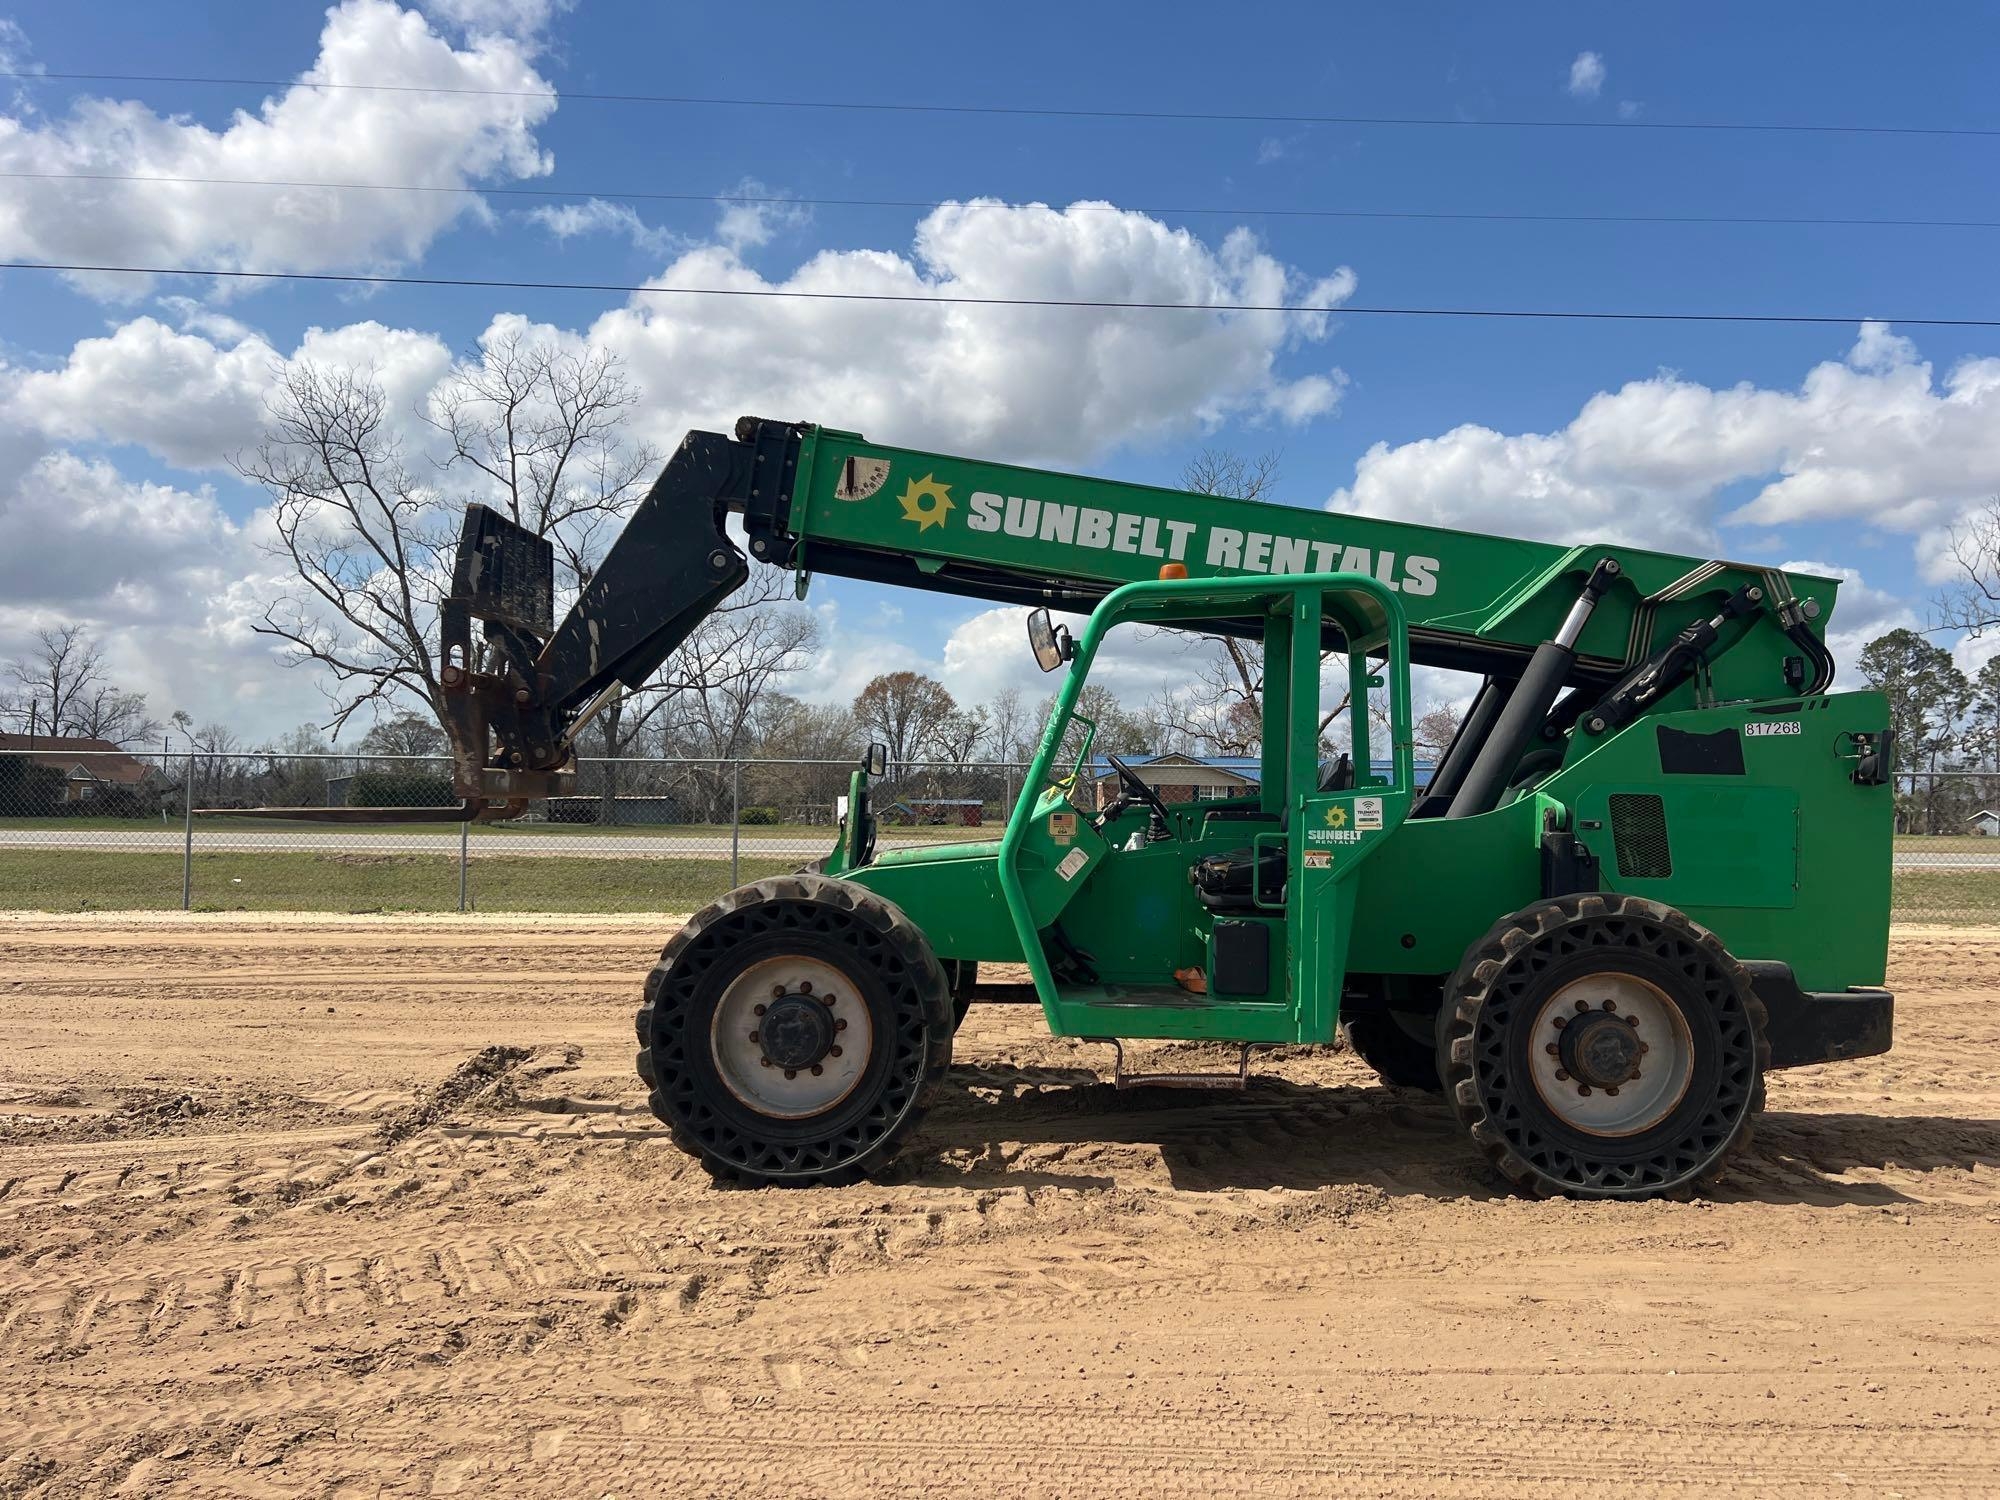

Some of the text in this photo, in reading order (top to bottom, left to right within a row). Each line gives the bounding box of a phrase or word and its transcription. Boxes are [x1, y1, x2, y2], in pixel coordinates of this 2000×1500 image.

[967, 491, 1440, 596] SUNBELT RENTALS
[1746, 722, 1800, 735] 817268
[1308, 830, 1363, 840] SUNBELT
